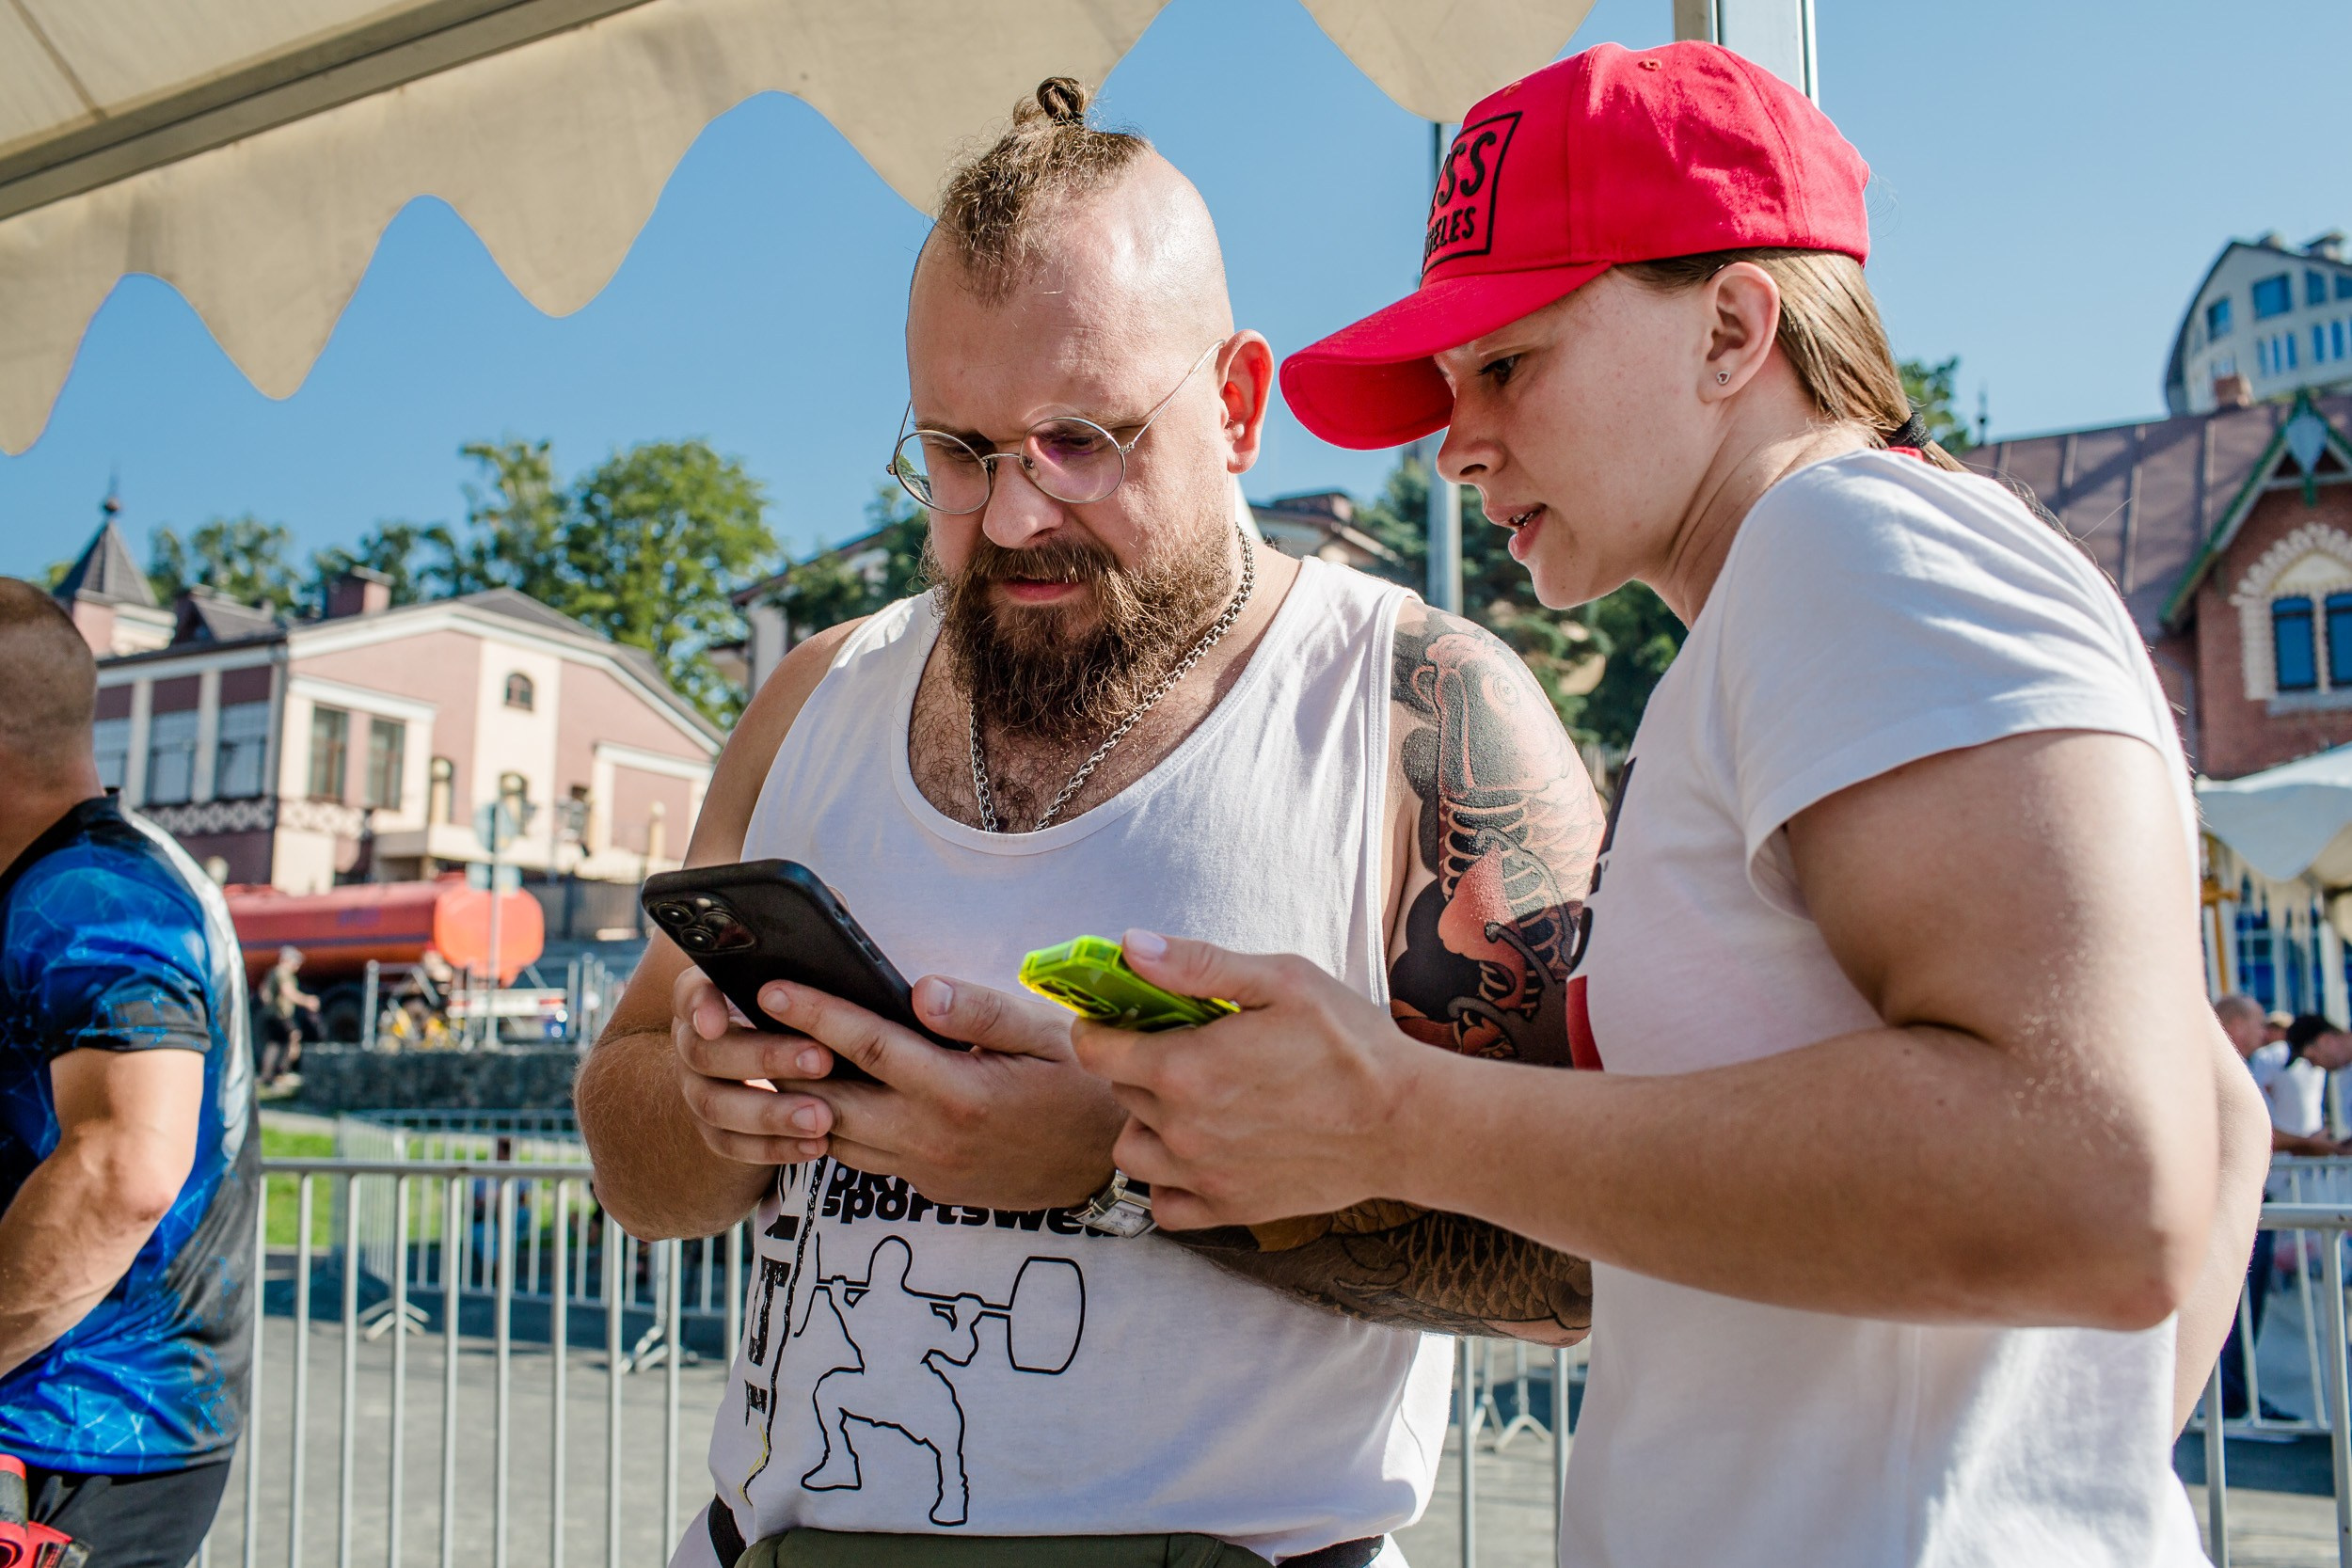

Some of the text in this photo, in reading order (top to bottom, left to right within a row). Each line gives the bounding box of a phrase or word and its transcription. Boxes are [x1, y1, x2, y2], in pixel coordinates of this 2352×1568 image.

[1432, 131, 1497, 213] SS
[1422, 206, 1477, 267] GELES
[821, 1188, 1120, 1237] sportswe
